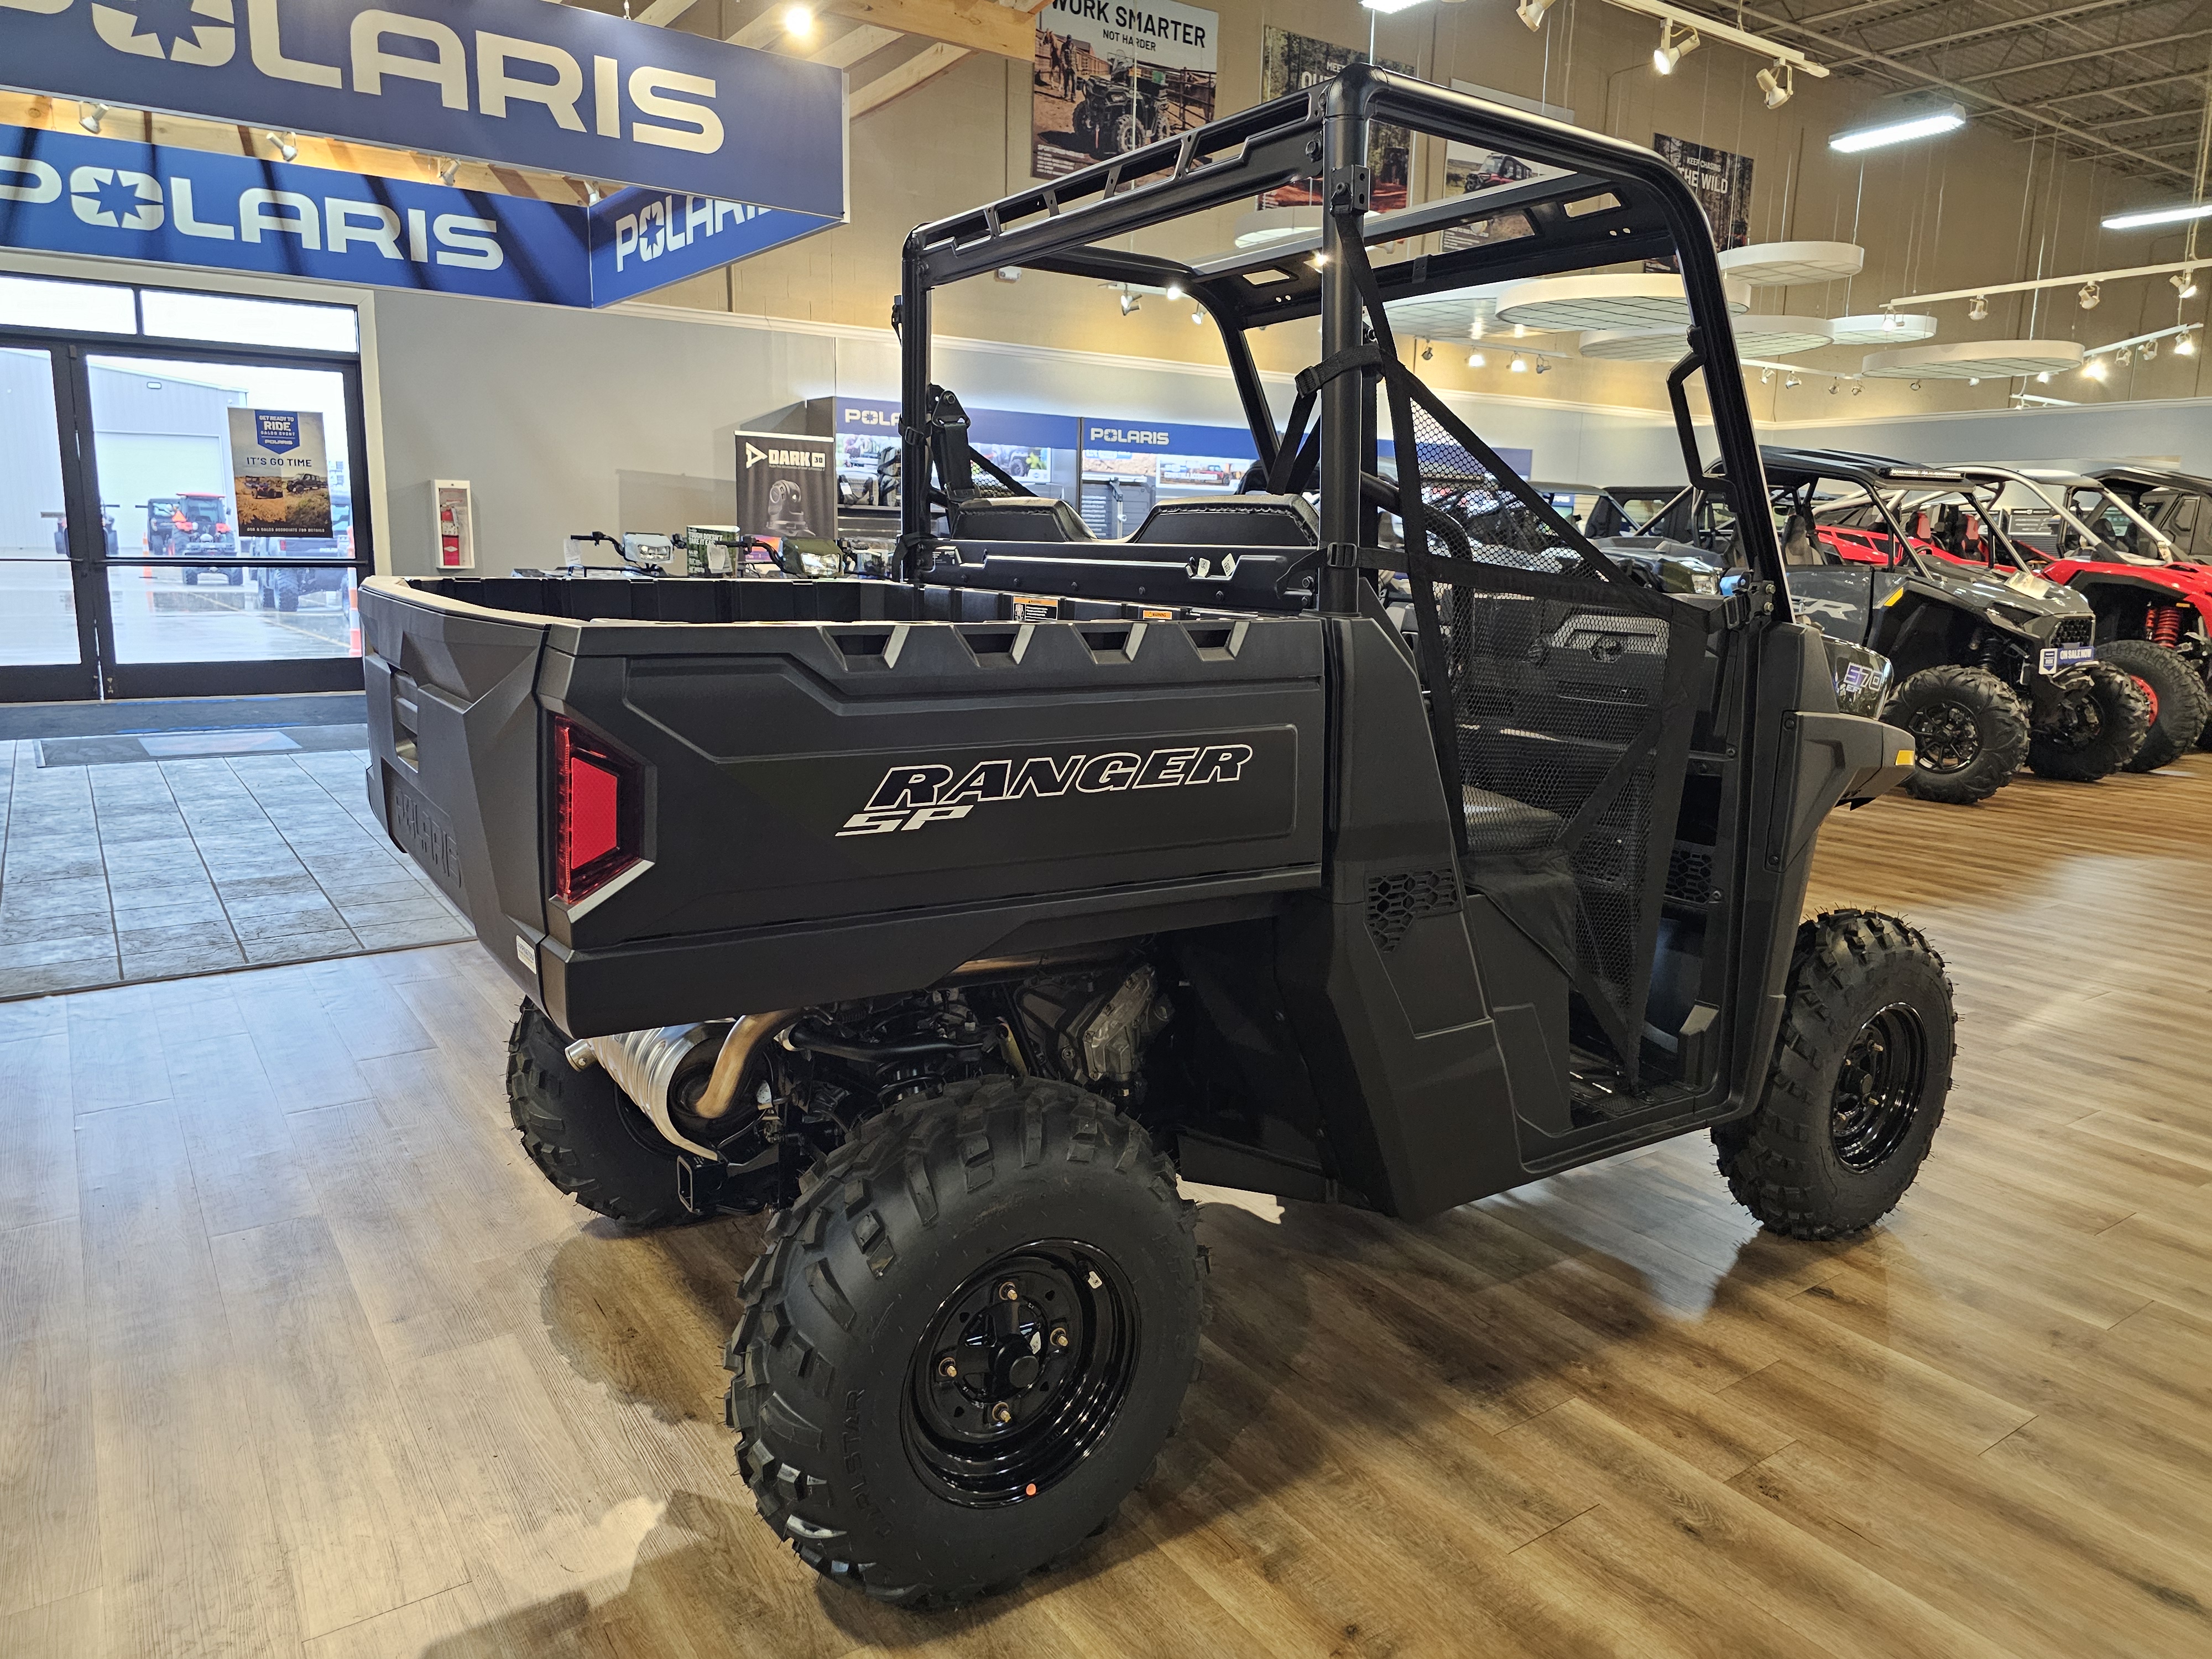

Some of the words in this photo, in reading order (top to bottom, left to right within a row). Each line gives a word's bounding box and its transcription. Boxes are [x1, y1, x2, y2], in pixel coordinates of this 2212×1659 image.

[1115, 6, 1206, 48] SMARTER
[1103, 28, 1119, 41] NOT
[1122, 34, 1156, 51] HARDER
[0, 0, 724, 154] OLARIS
[1687, 156, 1699, 166] KEEP
[1700, 159, 1721, 173] CHASING
[1677, 167, 1699, 187] THE
[1701, 173, 1728, 194] WILD
[615, 194, 772, 273] POLAR
[263, 421, 291, 431] RIDE
[845, 408, 902, 426] POLA
[1090, 427, 1170, 445] POLARIS
[286, 458, 312, 467] TIME
[768, 449, 811, 467] DARK
[2060, 650, 2068, 660] ON
[2068, 649, 2080, 659] SALE
[2080, 648, 2092, 658] NOW
[1843, 662, 1884, 692] 570
[863, 744, 1253, 811] RANGER
[835, 805, 974, 837] SP
